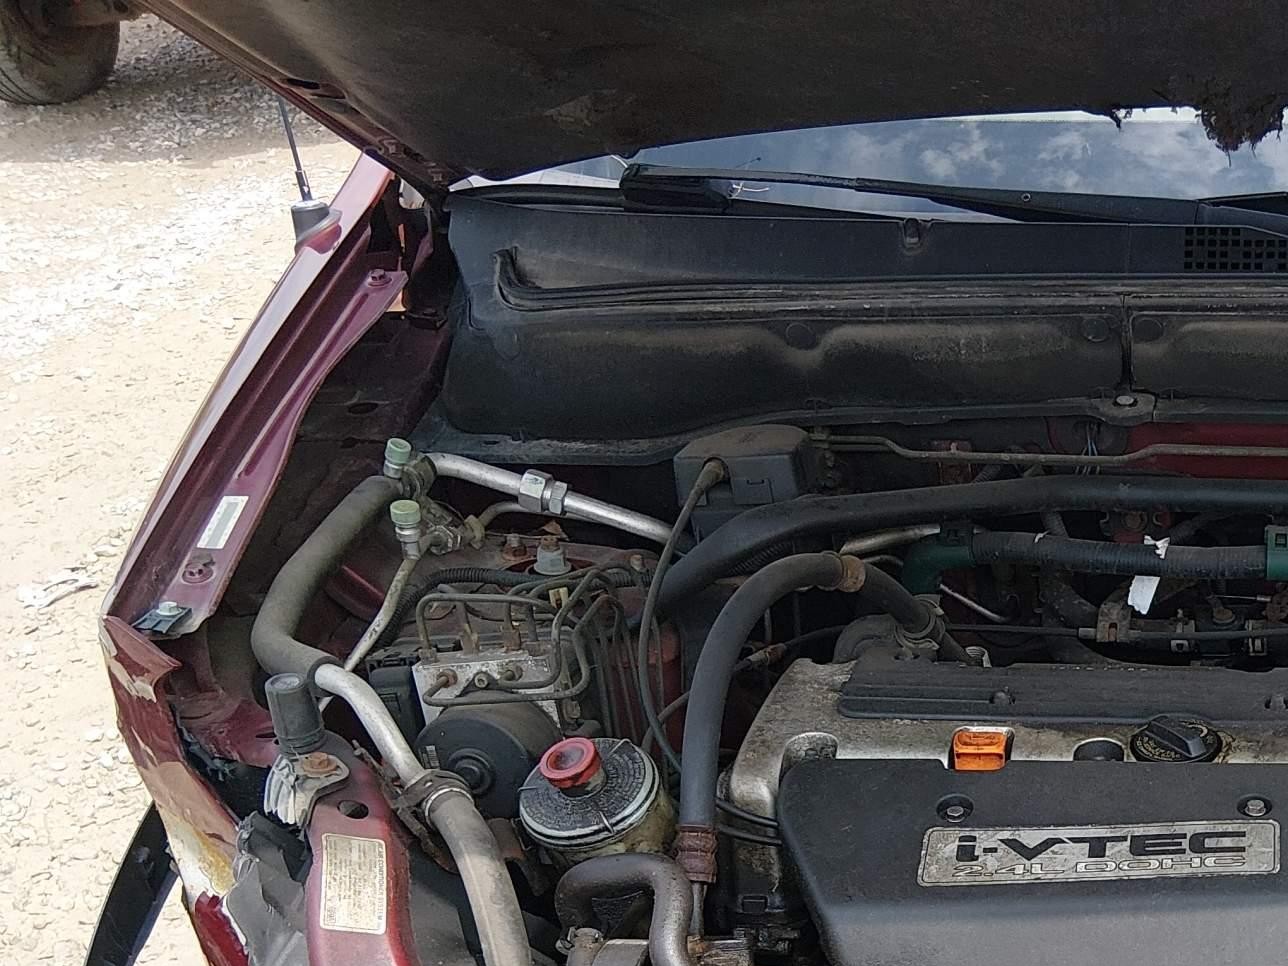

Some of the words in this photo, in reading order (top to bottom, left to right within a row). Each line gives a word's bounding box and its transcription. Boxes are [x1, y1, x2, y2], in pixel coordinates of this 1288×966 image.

[956, 831, 1247, 863] i-VTEC
[952, 862, 1065, 878] 2.4L
[1075, 855, 1247, 874] DOHC
